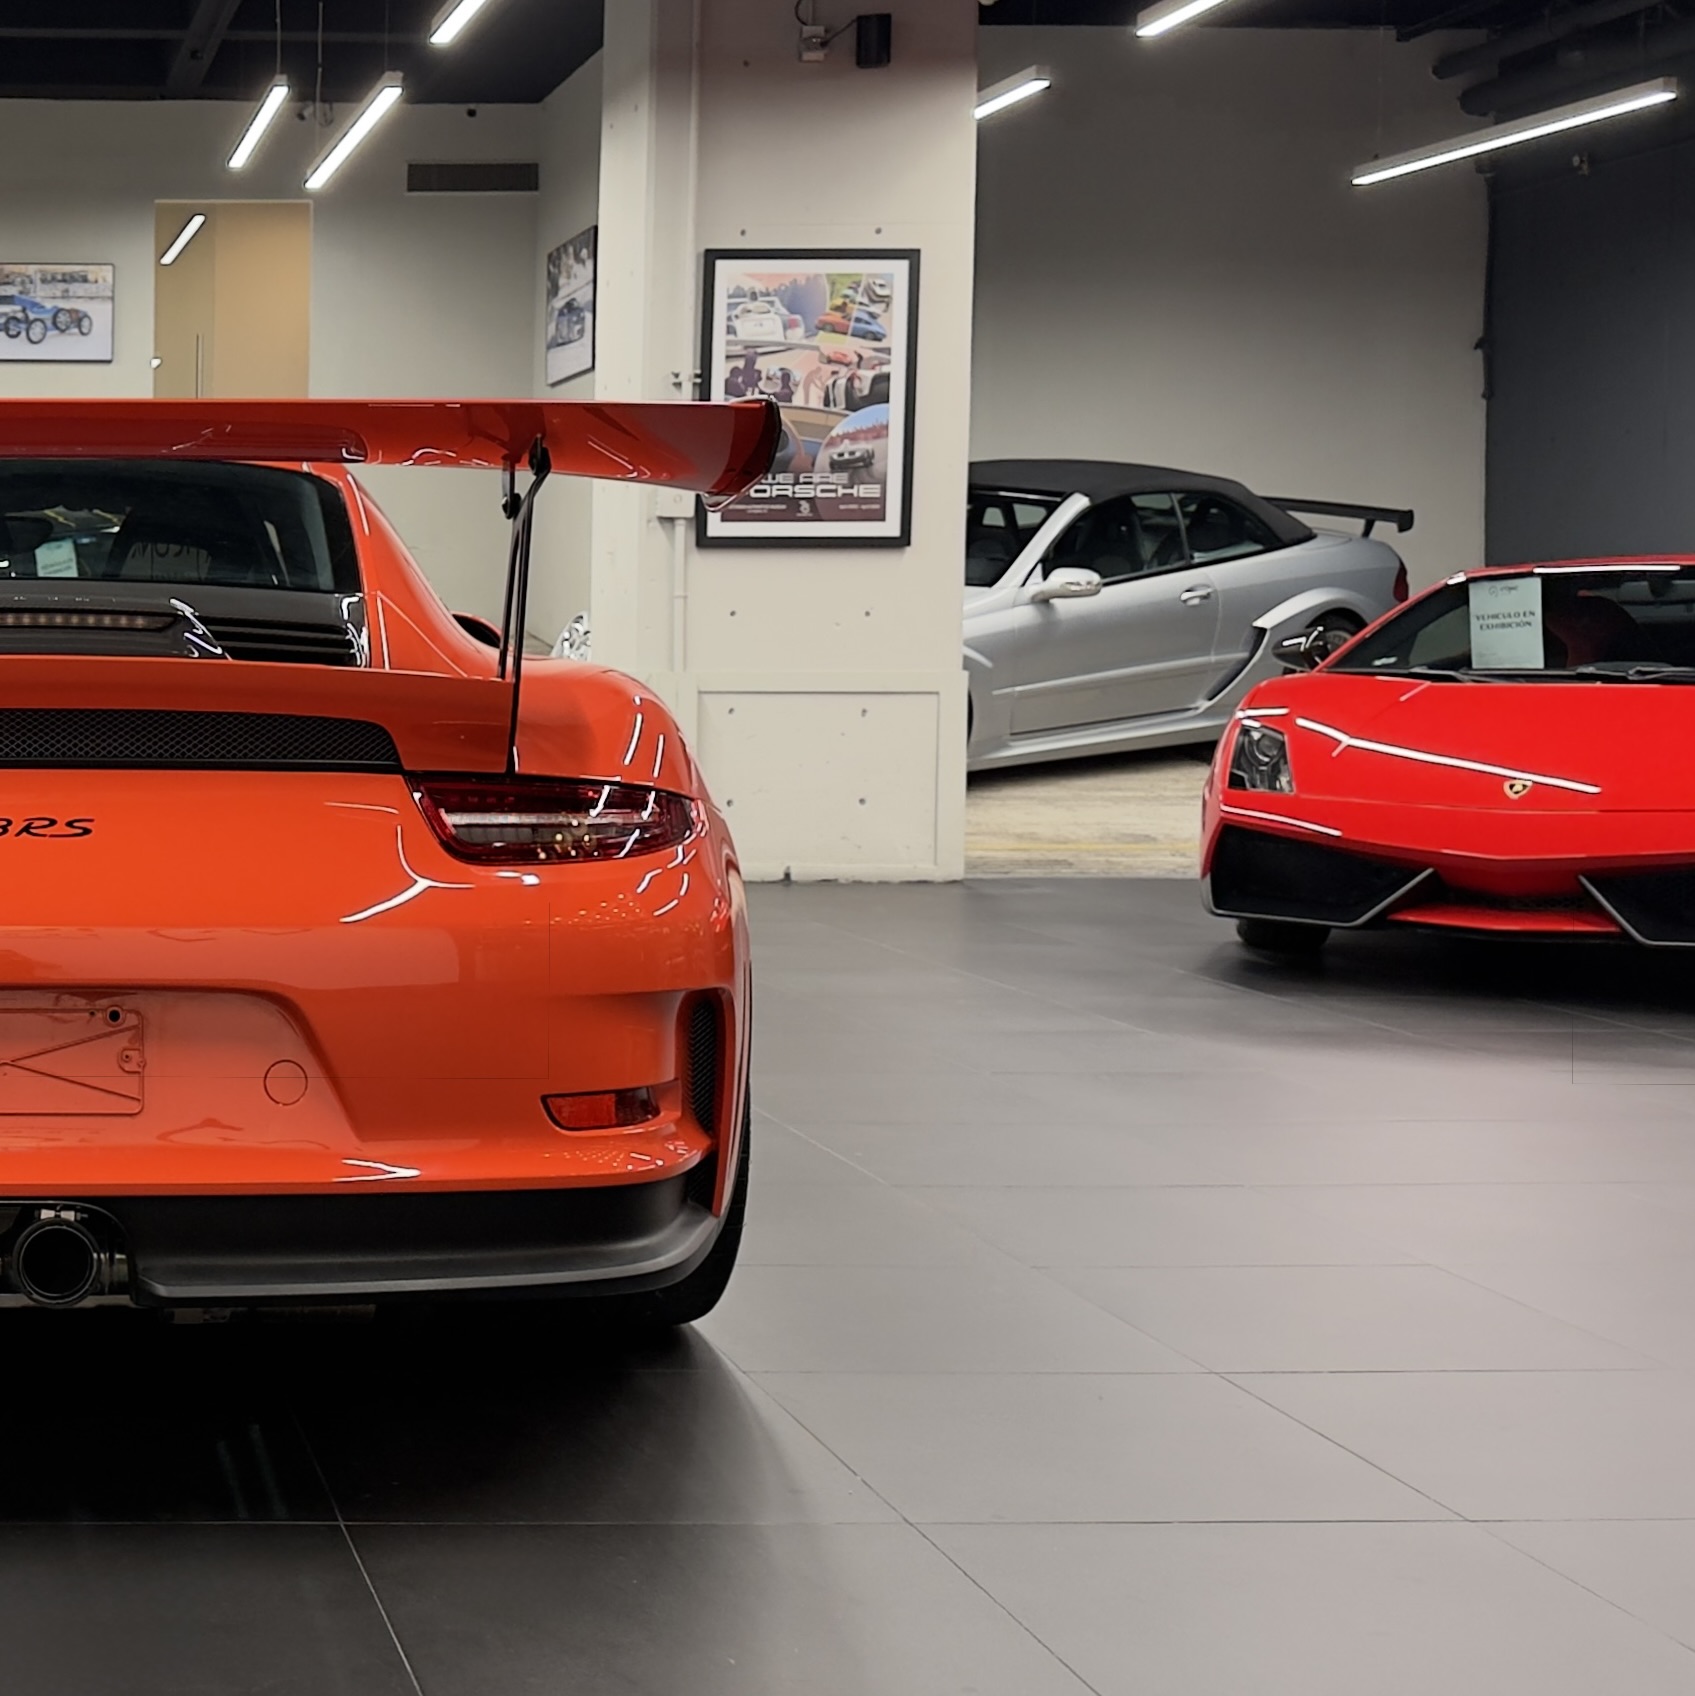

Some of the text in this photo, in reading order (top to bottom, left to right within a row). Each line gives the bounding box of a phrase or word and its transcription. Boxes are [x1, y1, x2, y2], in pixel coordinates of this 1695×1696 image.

[761, 472, 849, 484] WE ARE
[746, 484, 881, 498] ORSCHE
[1522, 610, 1536, 618] EN
